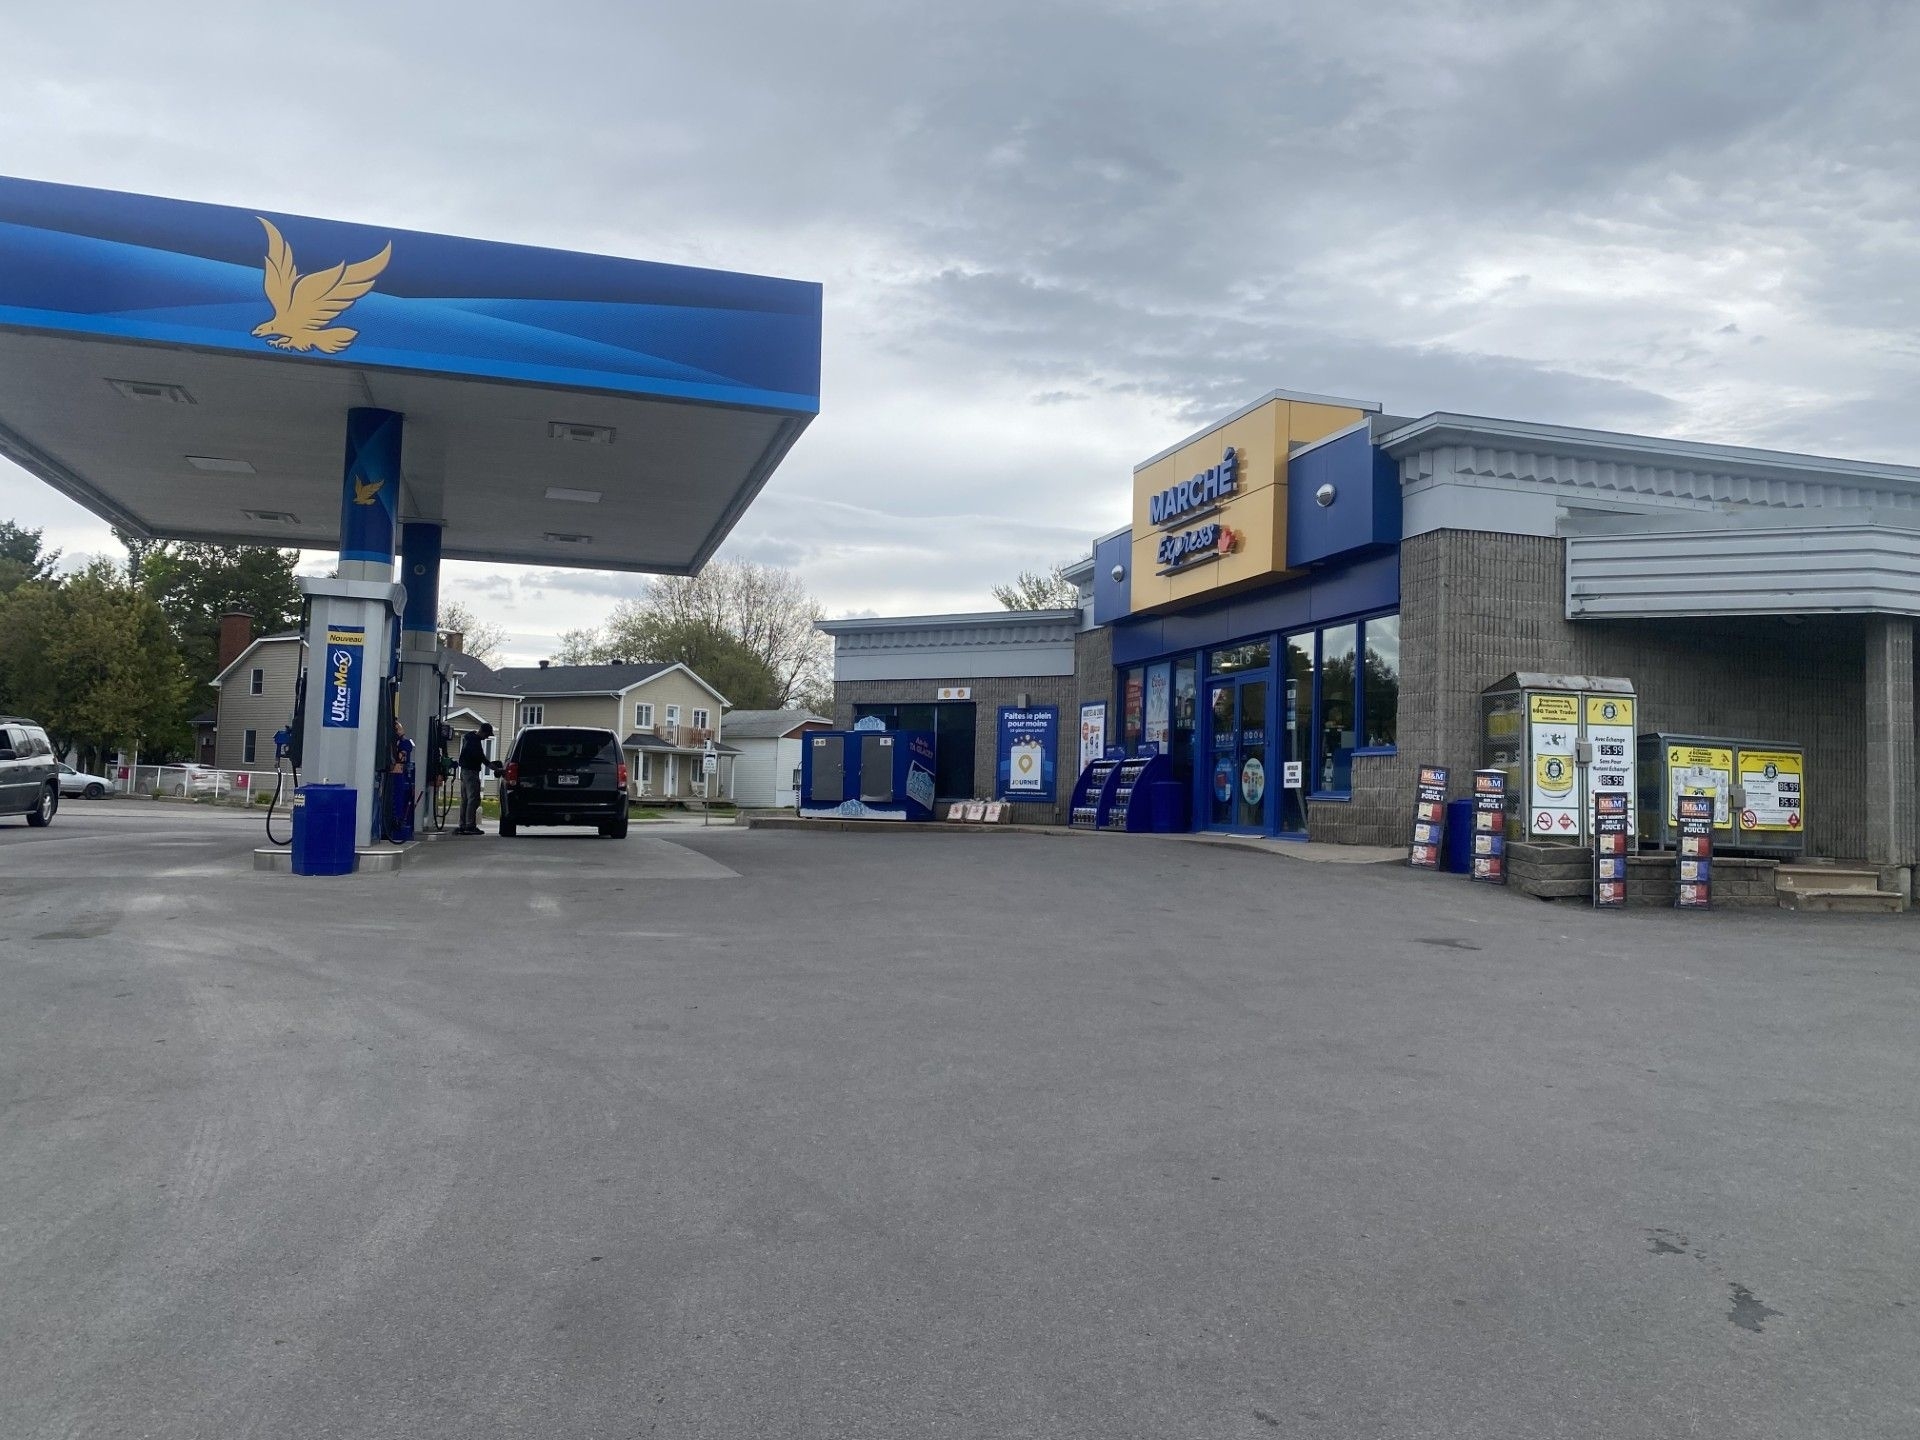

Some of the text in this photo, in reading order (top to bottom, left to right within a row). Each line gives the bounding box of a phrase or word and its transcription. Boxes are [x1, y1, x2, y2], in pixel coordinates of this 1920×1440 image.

[1150, 447, 1238, 525] MARCHÉ
[1157, 523, 1220, 565] Express
[329, 634, 362, 643] Nouveau
[331, 649, 350, 722] UltraMax
[1004, 711, 1052, 721] Faites le plein
[1601, 745, 1623, 755] 35.99
[1423, 770, 1444, 780] M&M
[1602, 775, 1623, 785] 86.99
[1479, 779, 1501, 787] M&M
[1421, 793, 1440, 801] POUCE
[1600, 800, 1622, 808] M&M
[1683, 803, 1707, 812] M&M
